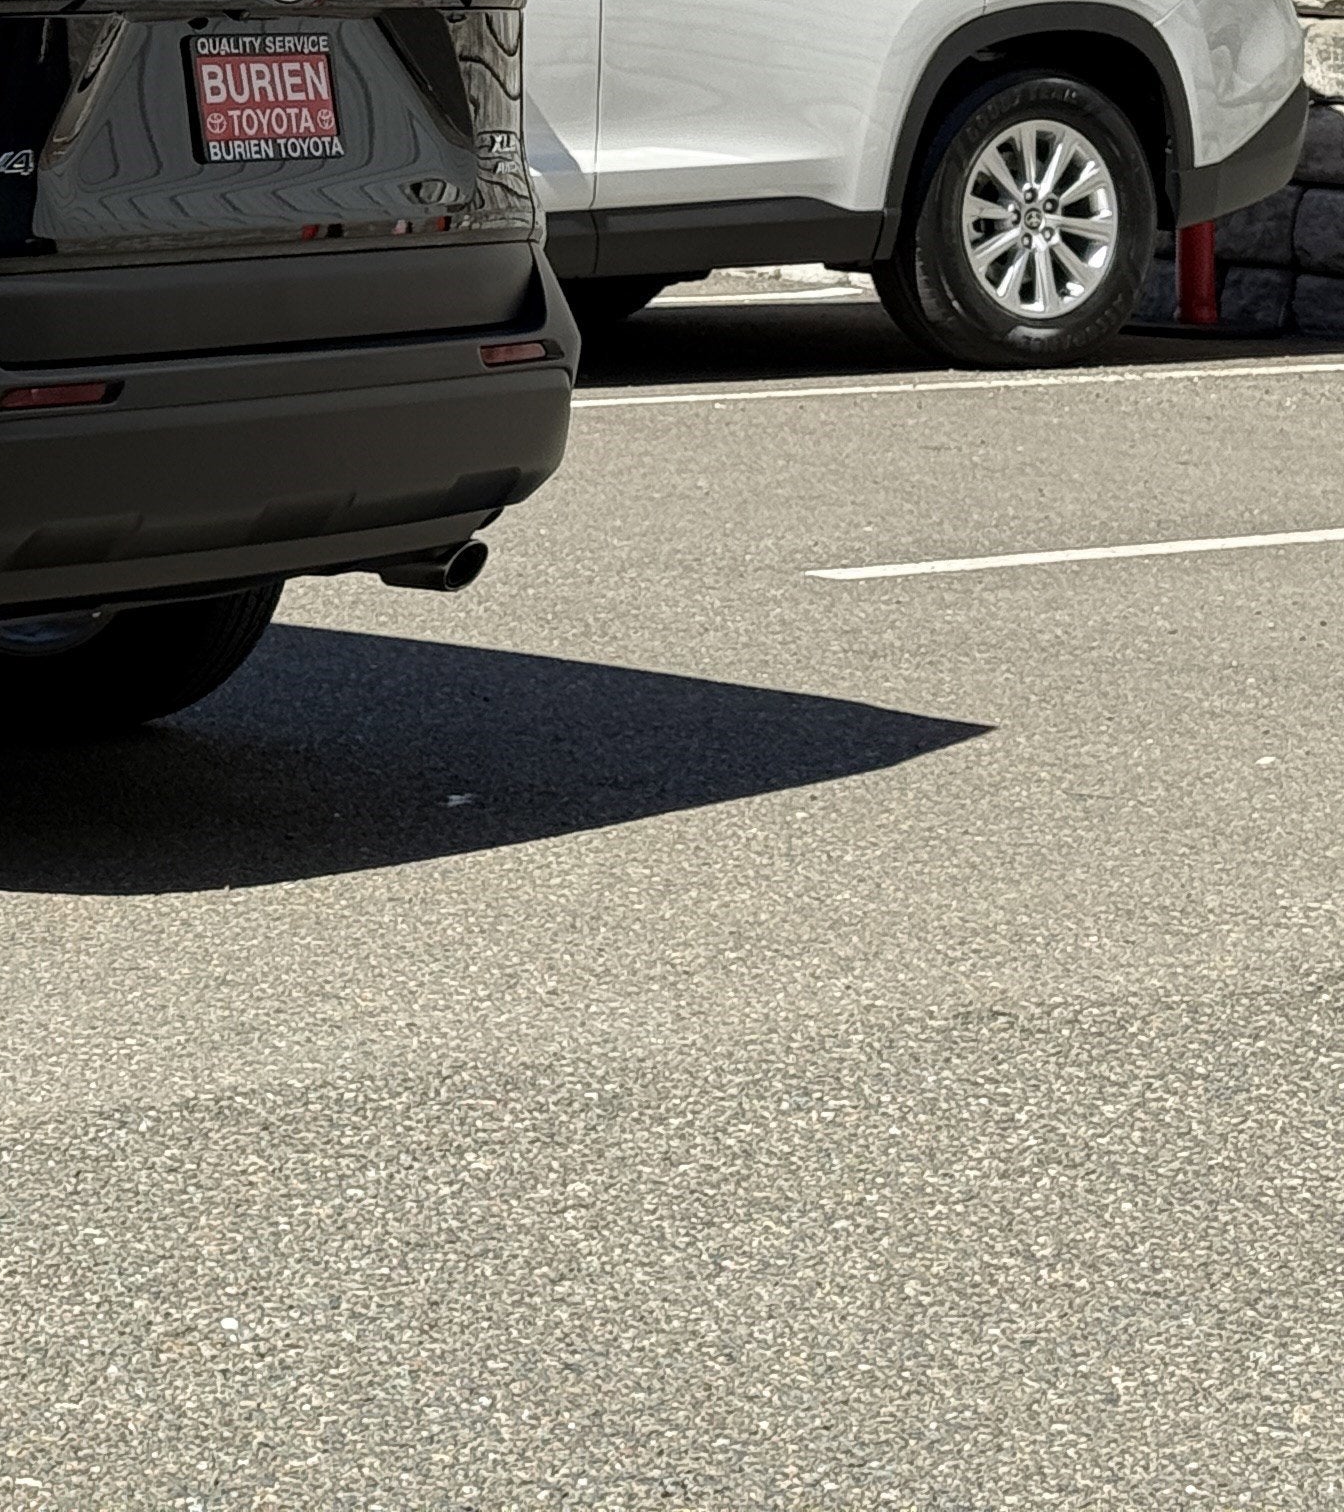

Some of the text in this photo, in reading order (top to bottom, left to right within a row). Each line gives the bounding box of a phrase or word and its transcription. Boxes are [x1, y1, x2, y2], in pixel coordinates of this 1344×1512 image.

[197, 35, 330, 55] QUALITY SERVICE
[201, 61, 330, 104] BURIEN
[227, 107, 316, 137] TOYOTA
[209, 136, 345, 161] BURIEN TOYOTA
